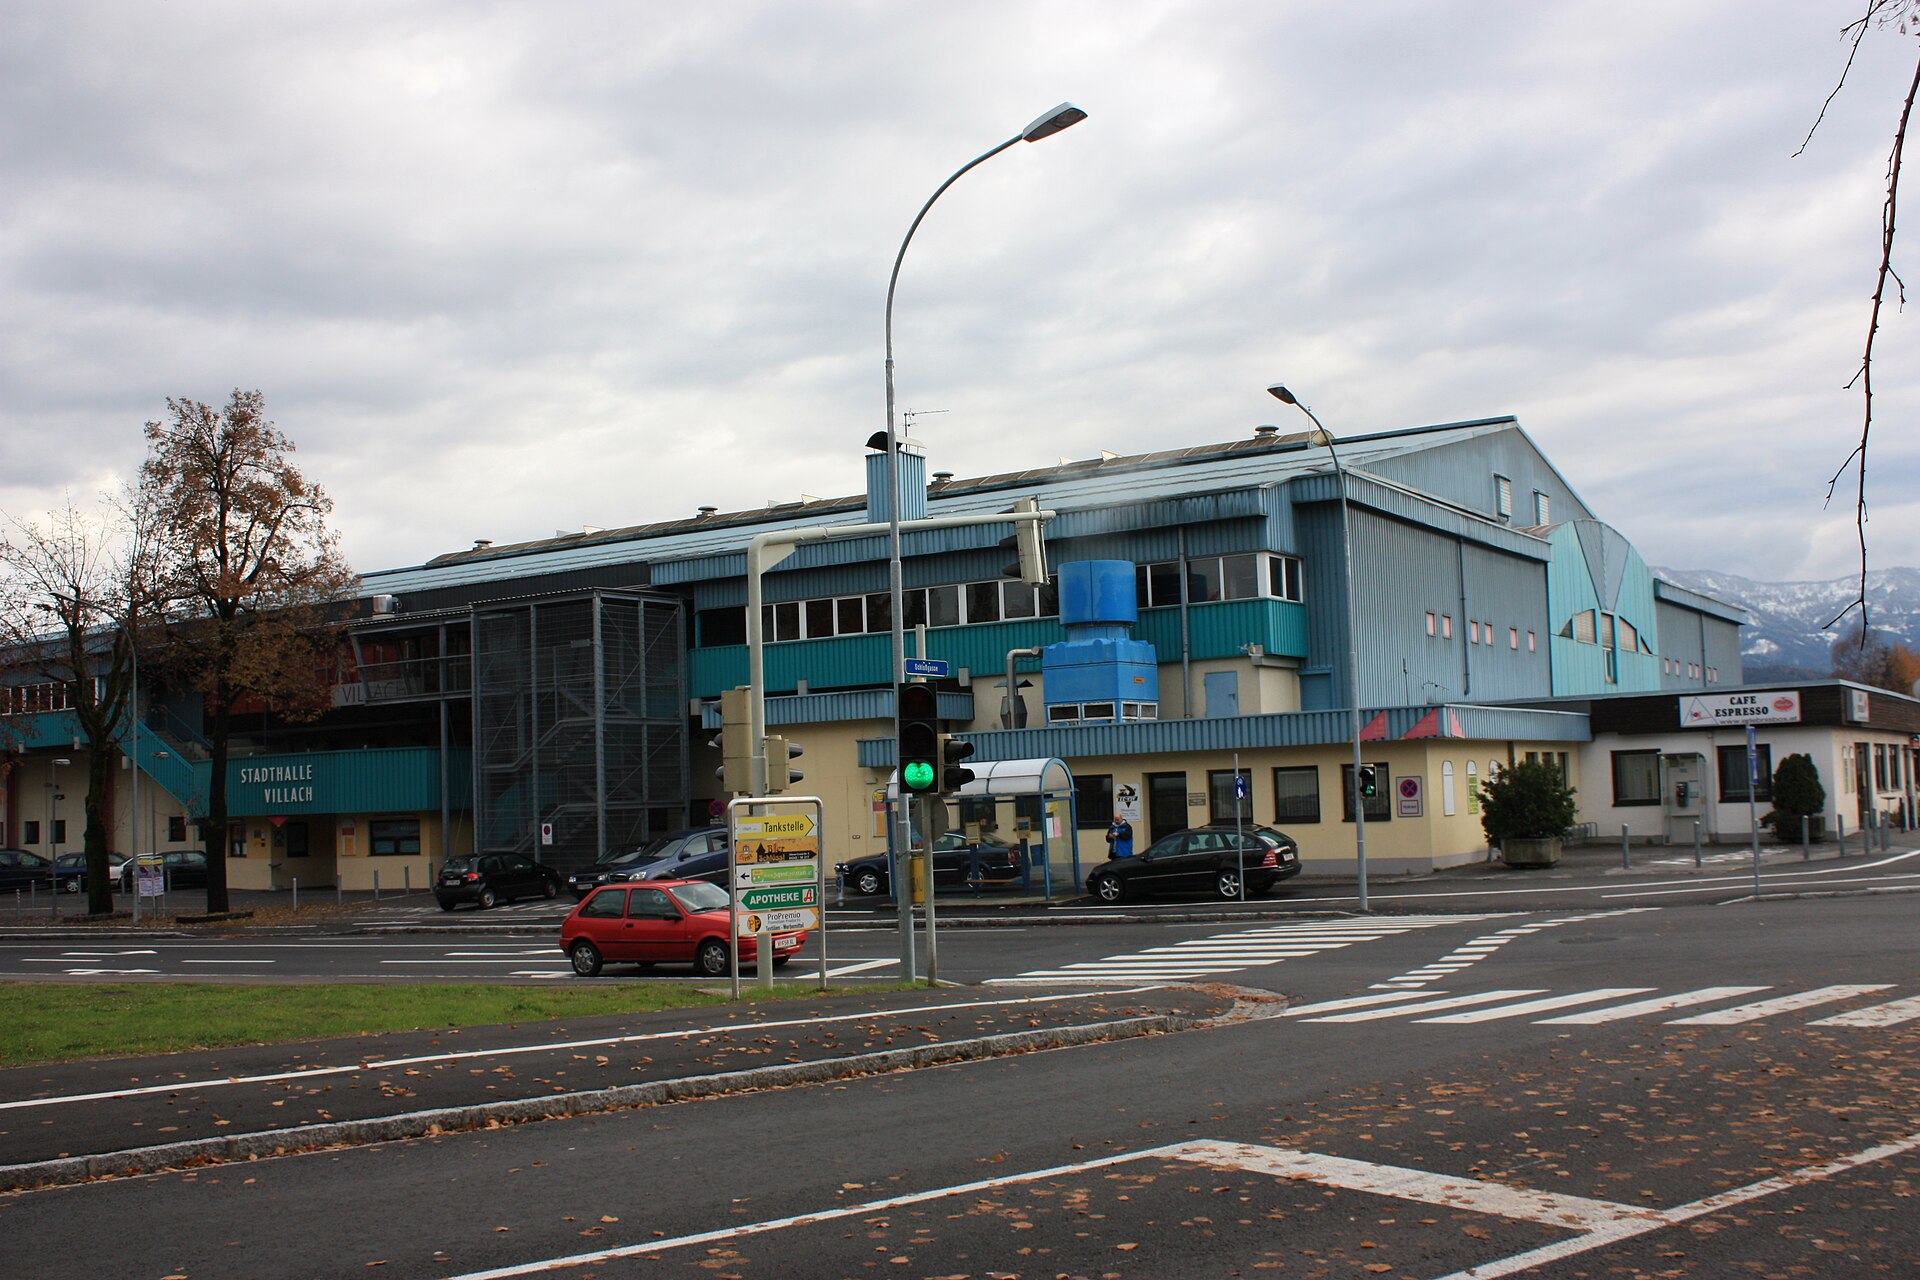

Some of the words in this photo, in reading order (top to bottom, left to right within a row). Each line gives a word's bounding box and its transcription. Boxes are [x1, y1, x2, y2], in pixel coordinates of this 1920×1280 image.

[1729, 696, 1756, 705] CAFE
[1715, 707, 1769, 717] ESPRESSO
[240, 764, 312, 784] STADTHALLE
[264, 787, 312, 803] VILLACH
[764, 821, 804, 833] Tankstelle
[750, 892, 800, 905] APOTHEKE
[767, 911, 801, 920] ProPremio
